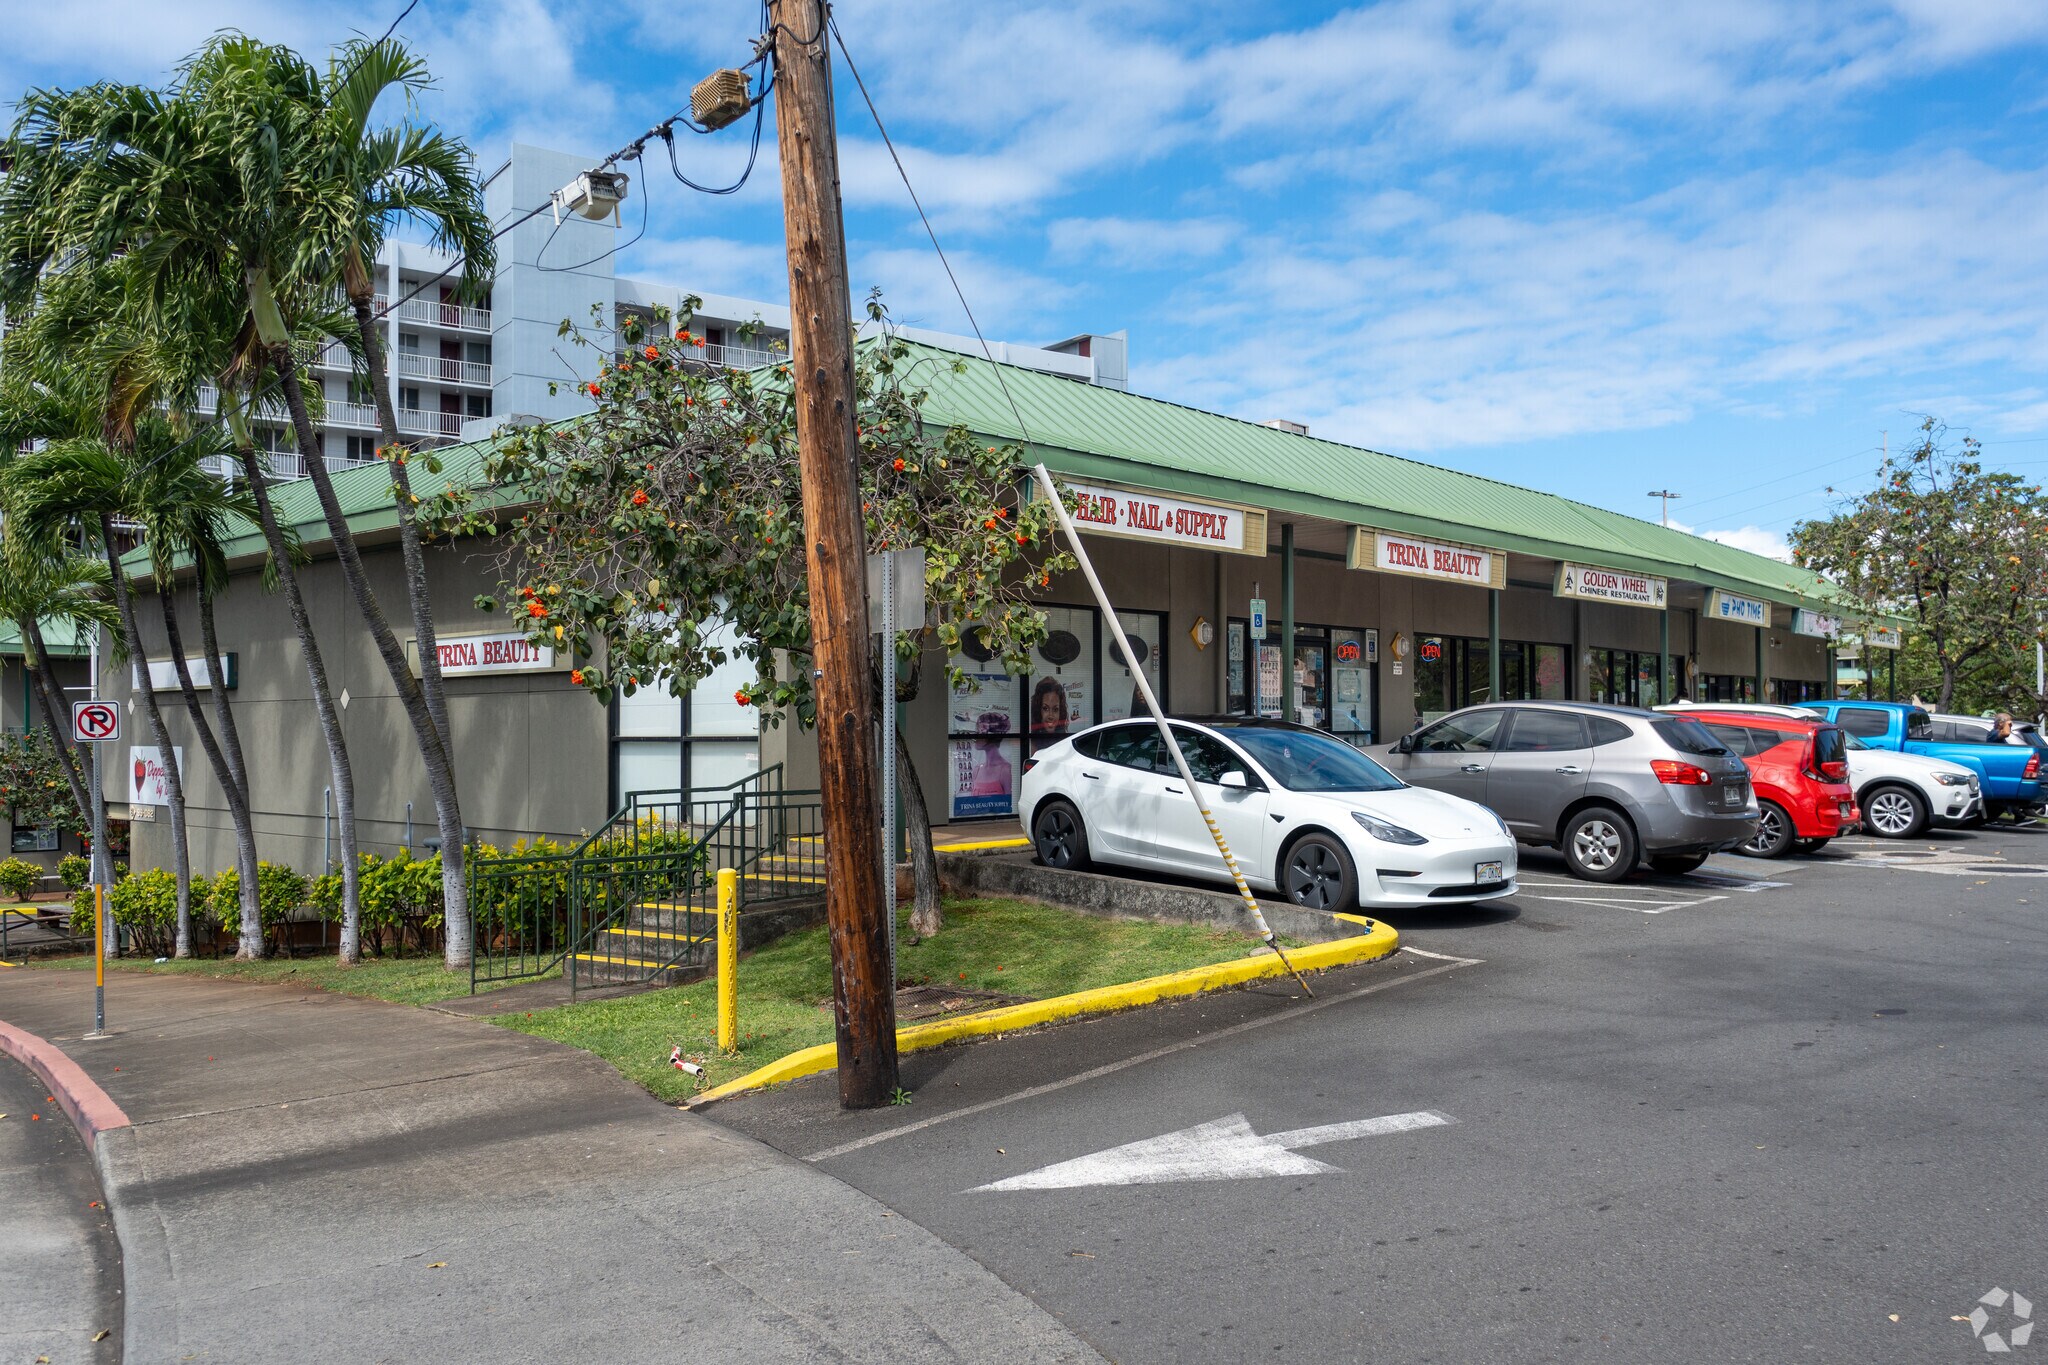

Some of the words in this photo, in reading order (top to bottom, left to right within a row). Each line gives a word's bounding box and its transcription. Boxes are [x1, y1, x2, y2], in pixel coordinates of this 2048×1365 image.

[1077, 493, 1116, 525] HAIR
[1127, 500, 1162, 531] NAIL
[1165, 511, 1173, 527] &
[1175, 508, 1228, 540] SUPPLY
[1387, 542, 1428, 569] TRINA
[1433, 550, 1482, 576] BEAUTY
[1583, 571, 1618, 589] GOLDEN
[1621, 577, 1647, 593] WHEEL
[1580, 586, 1607, 597] CHINESE
[1610, 591, 1650, 602] RESTAURANT
[436, 643, 477, 667] TRINA
[1338, 645, 1360, 659] OPEN
[1422, 645, 1440, 657] OPEN
